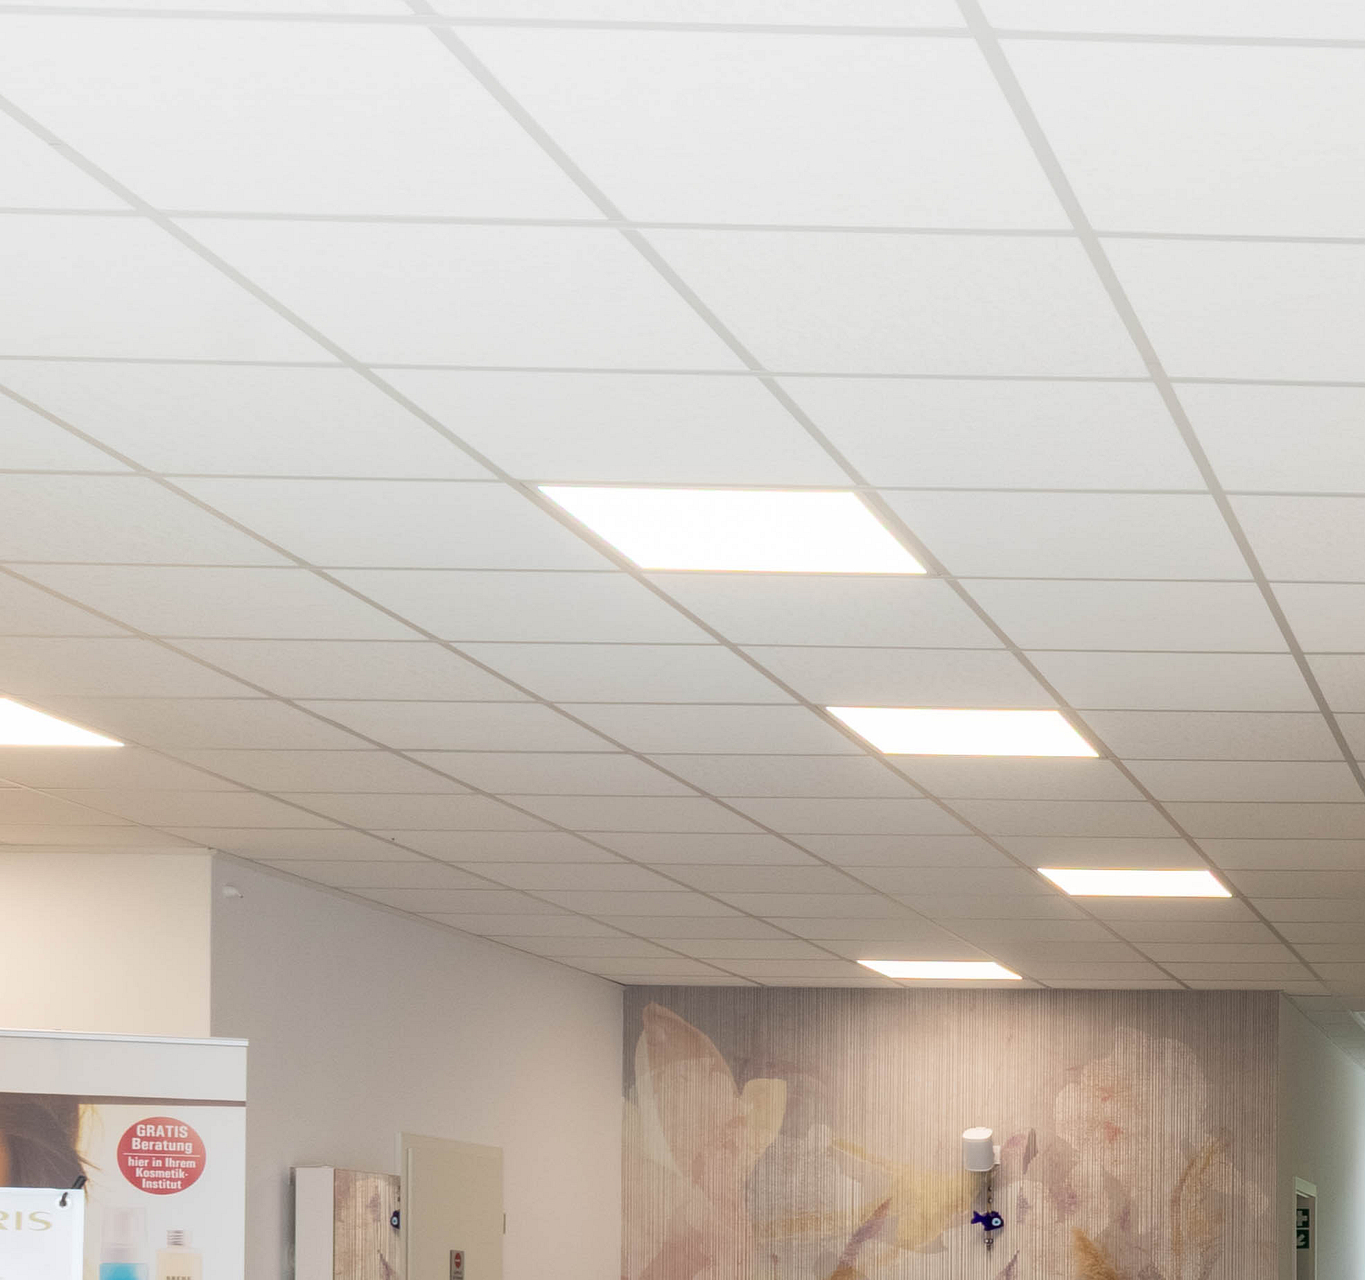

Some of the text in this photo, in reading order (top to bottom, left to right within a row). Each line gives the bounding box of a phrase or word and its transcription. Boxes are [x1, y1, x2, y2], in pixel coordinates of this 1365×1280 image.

[136, 1124, 188, 1138] GRATIS
[131, 1138, 193, 1154] Beratung
[128, 1157, 196, 1168] hier in Ihrem
[135, 1168, 188, 1178] Kosmetik-
[142, 1179, 182, 1189] Institut
